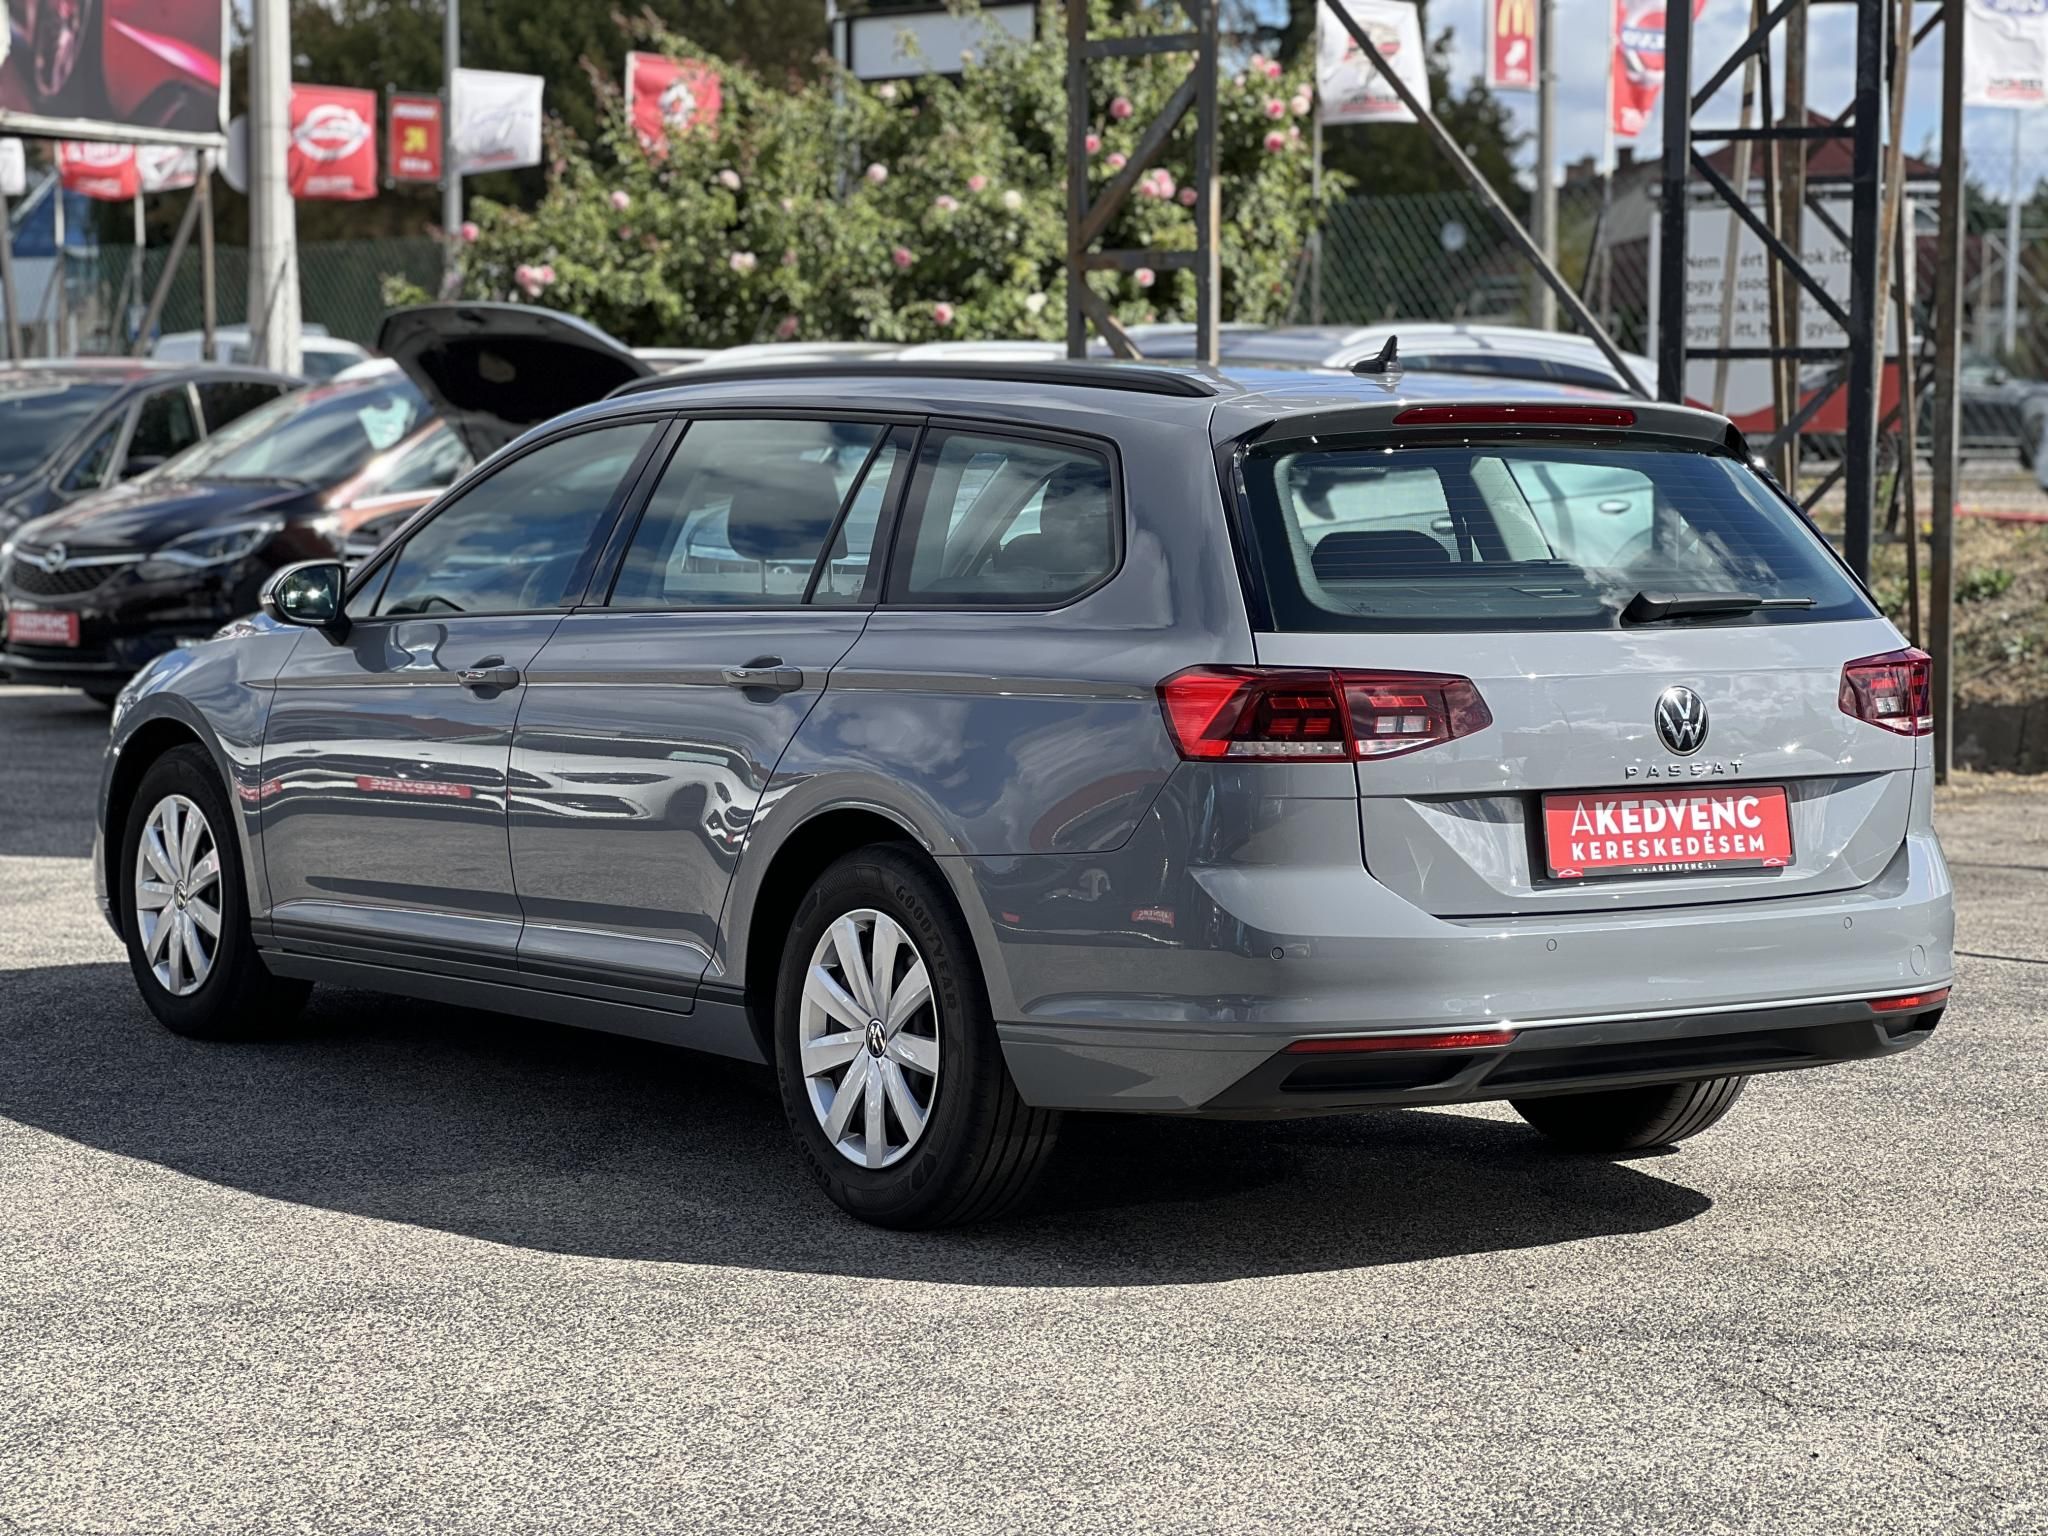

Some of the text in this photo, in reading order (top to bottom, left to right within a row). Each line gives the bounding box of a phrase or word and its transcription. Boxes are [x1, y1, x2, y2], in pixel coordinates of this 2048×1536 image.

[1624, 760, 1743, 780] PASSAT
[1571, 831, 1766, 861] KERESKEDÉSEM
[896, 885, 957, 1010] GOODYEAR
